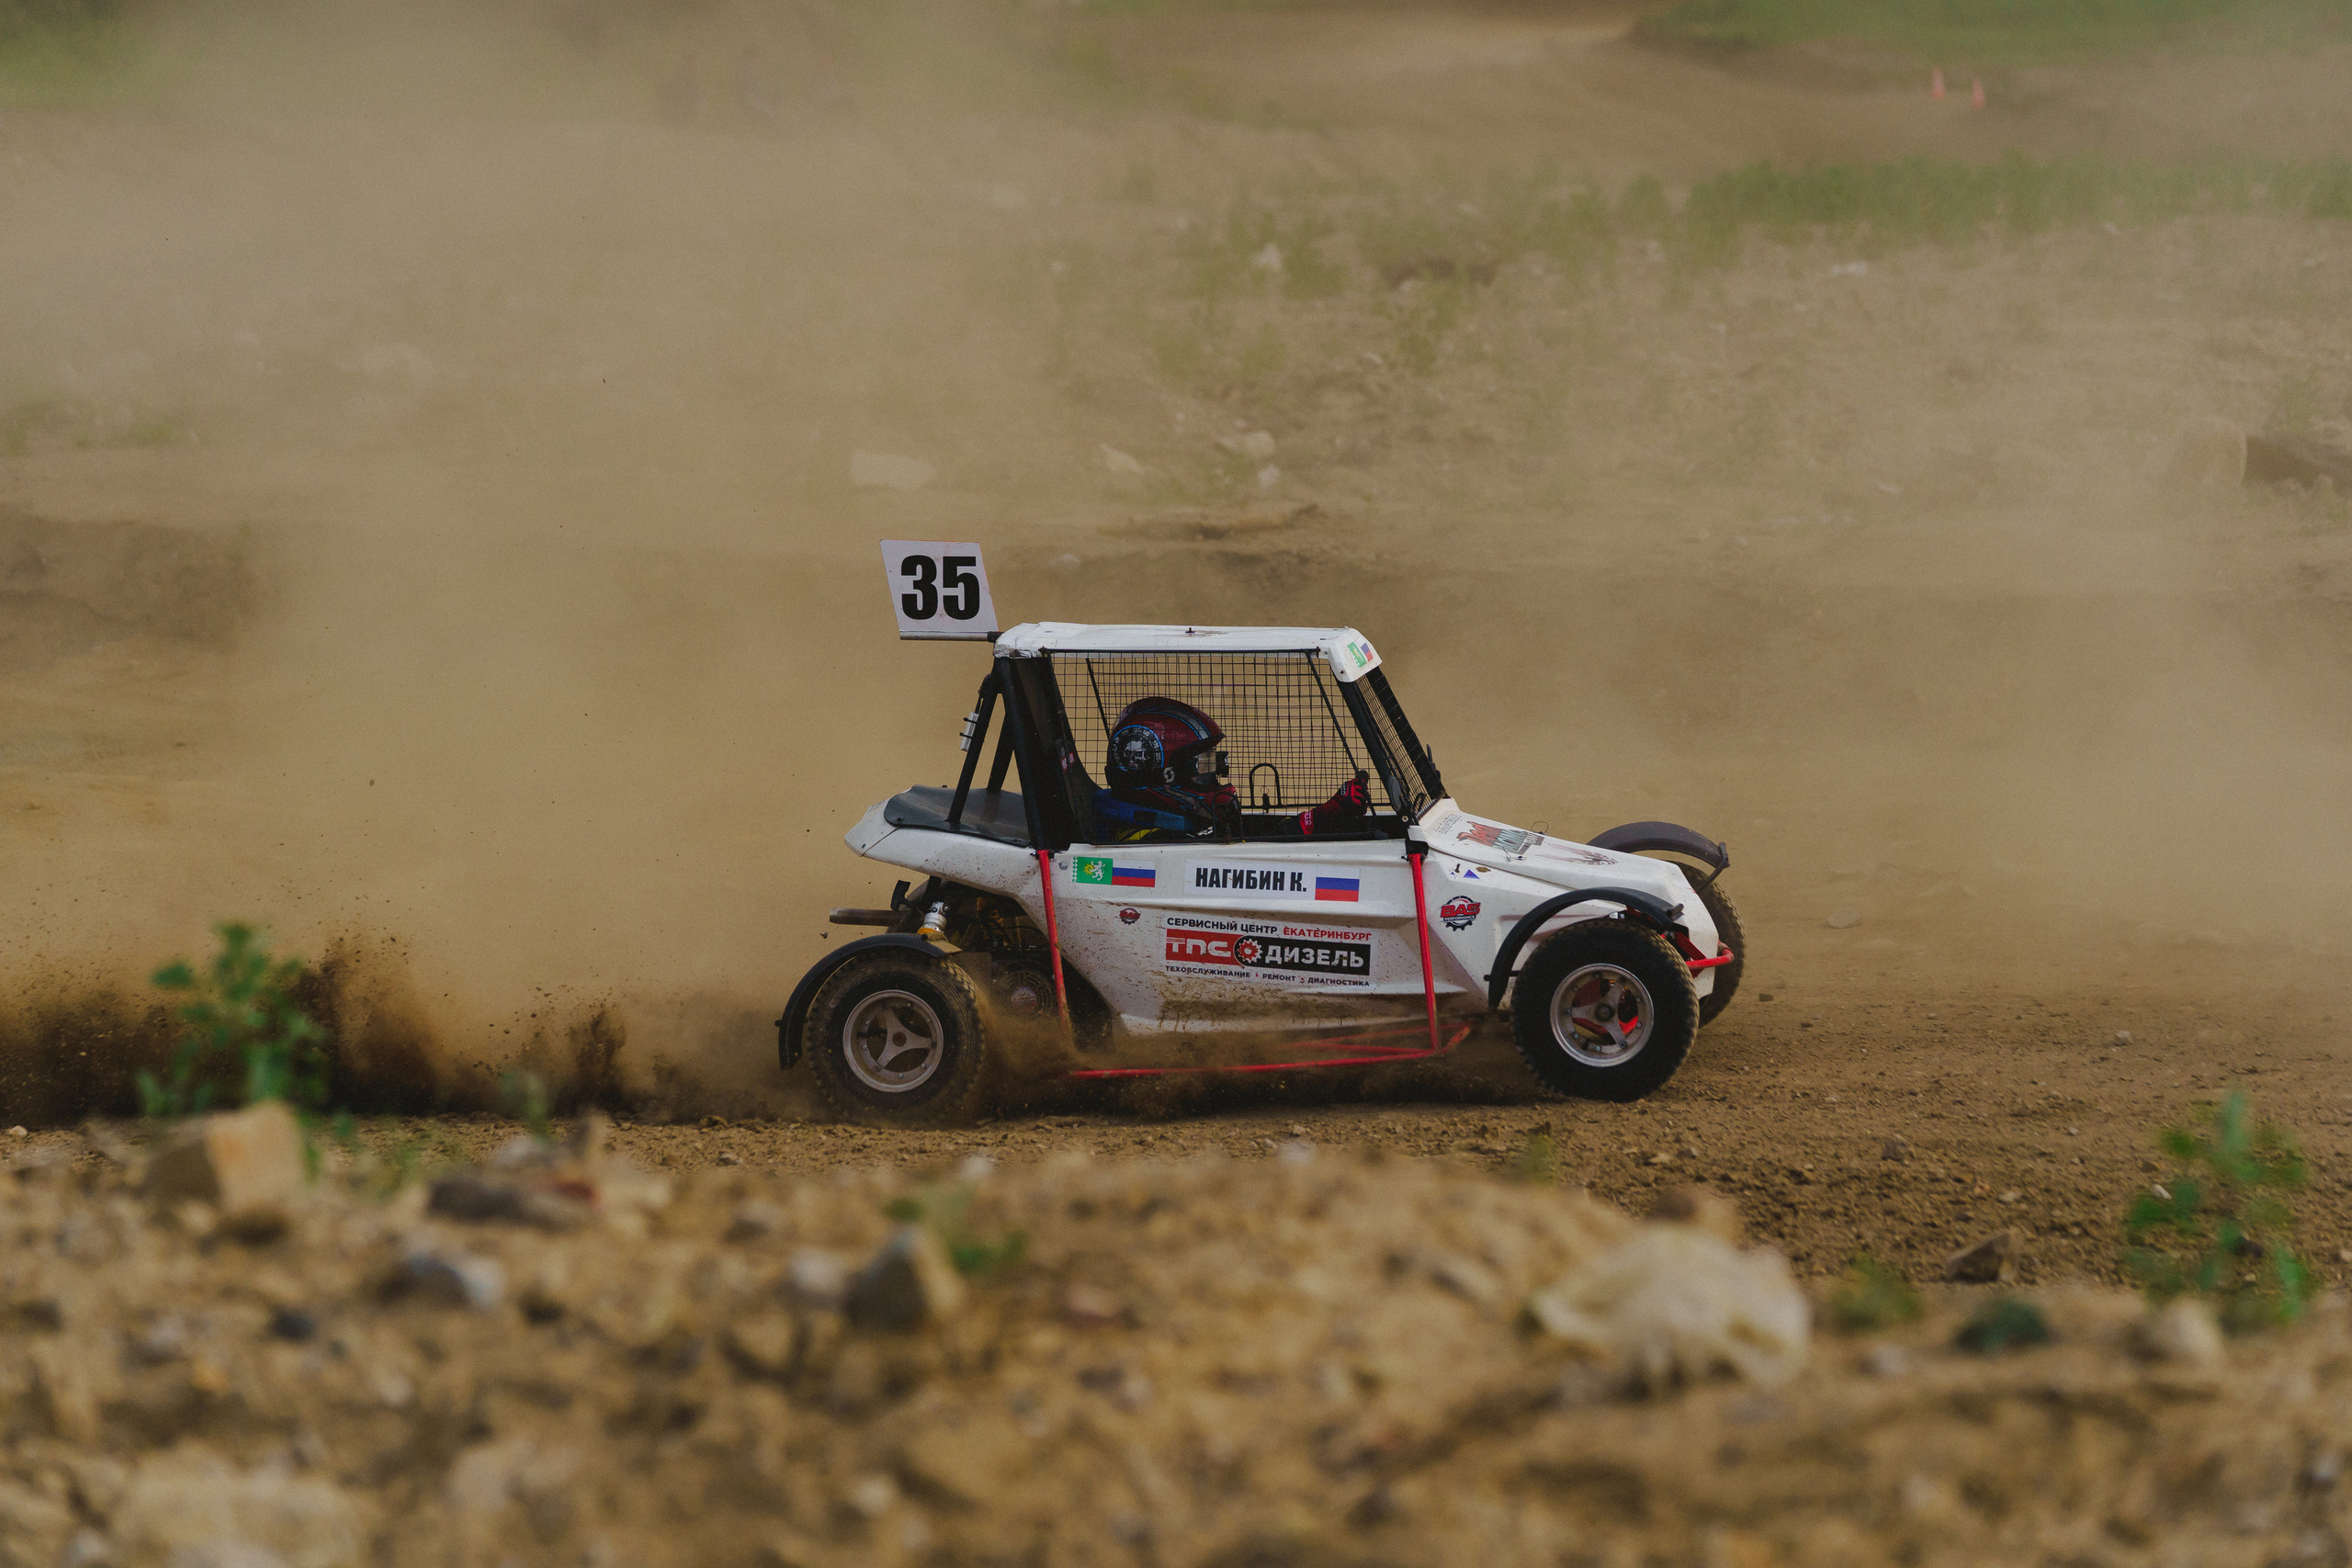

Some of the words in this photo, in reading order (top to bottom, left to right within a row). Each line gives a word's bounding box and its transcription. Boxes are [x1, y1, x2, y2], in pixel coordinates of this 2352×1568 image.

[900, 554, 980, 621] 35
[1195, 867, 1285, 891] НАГИБИН
[1289, 872, 1307, 893] К.
[1440, 902, 1481, 918] BAS
[1167, 918, 1238, 931] СЕРВИСНЫЙ
[1240, 924, 1278, 934] ЦЕНТР
[1283, 927, 1372, 941] ЕКАТЕРИНБУРГ
[1265, 944, 1364, 968] ДИЗЕЛЬ
[1165, 965, 1250, 978] ТЕХОБСЛУЖИВАНИЕ
[1262, 973, 1296, 982] РЕМОНТ
[1307, 976, 1370, 987] ДИАГНОСТИКА
